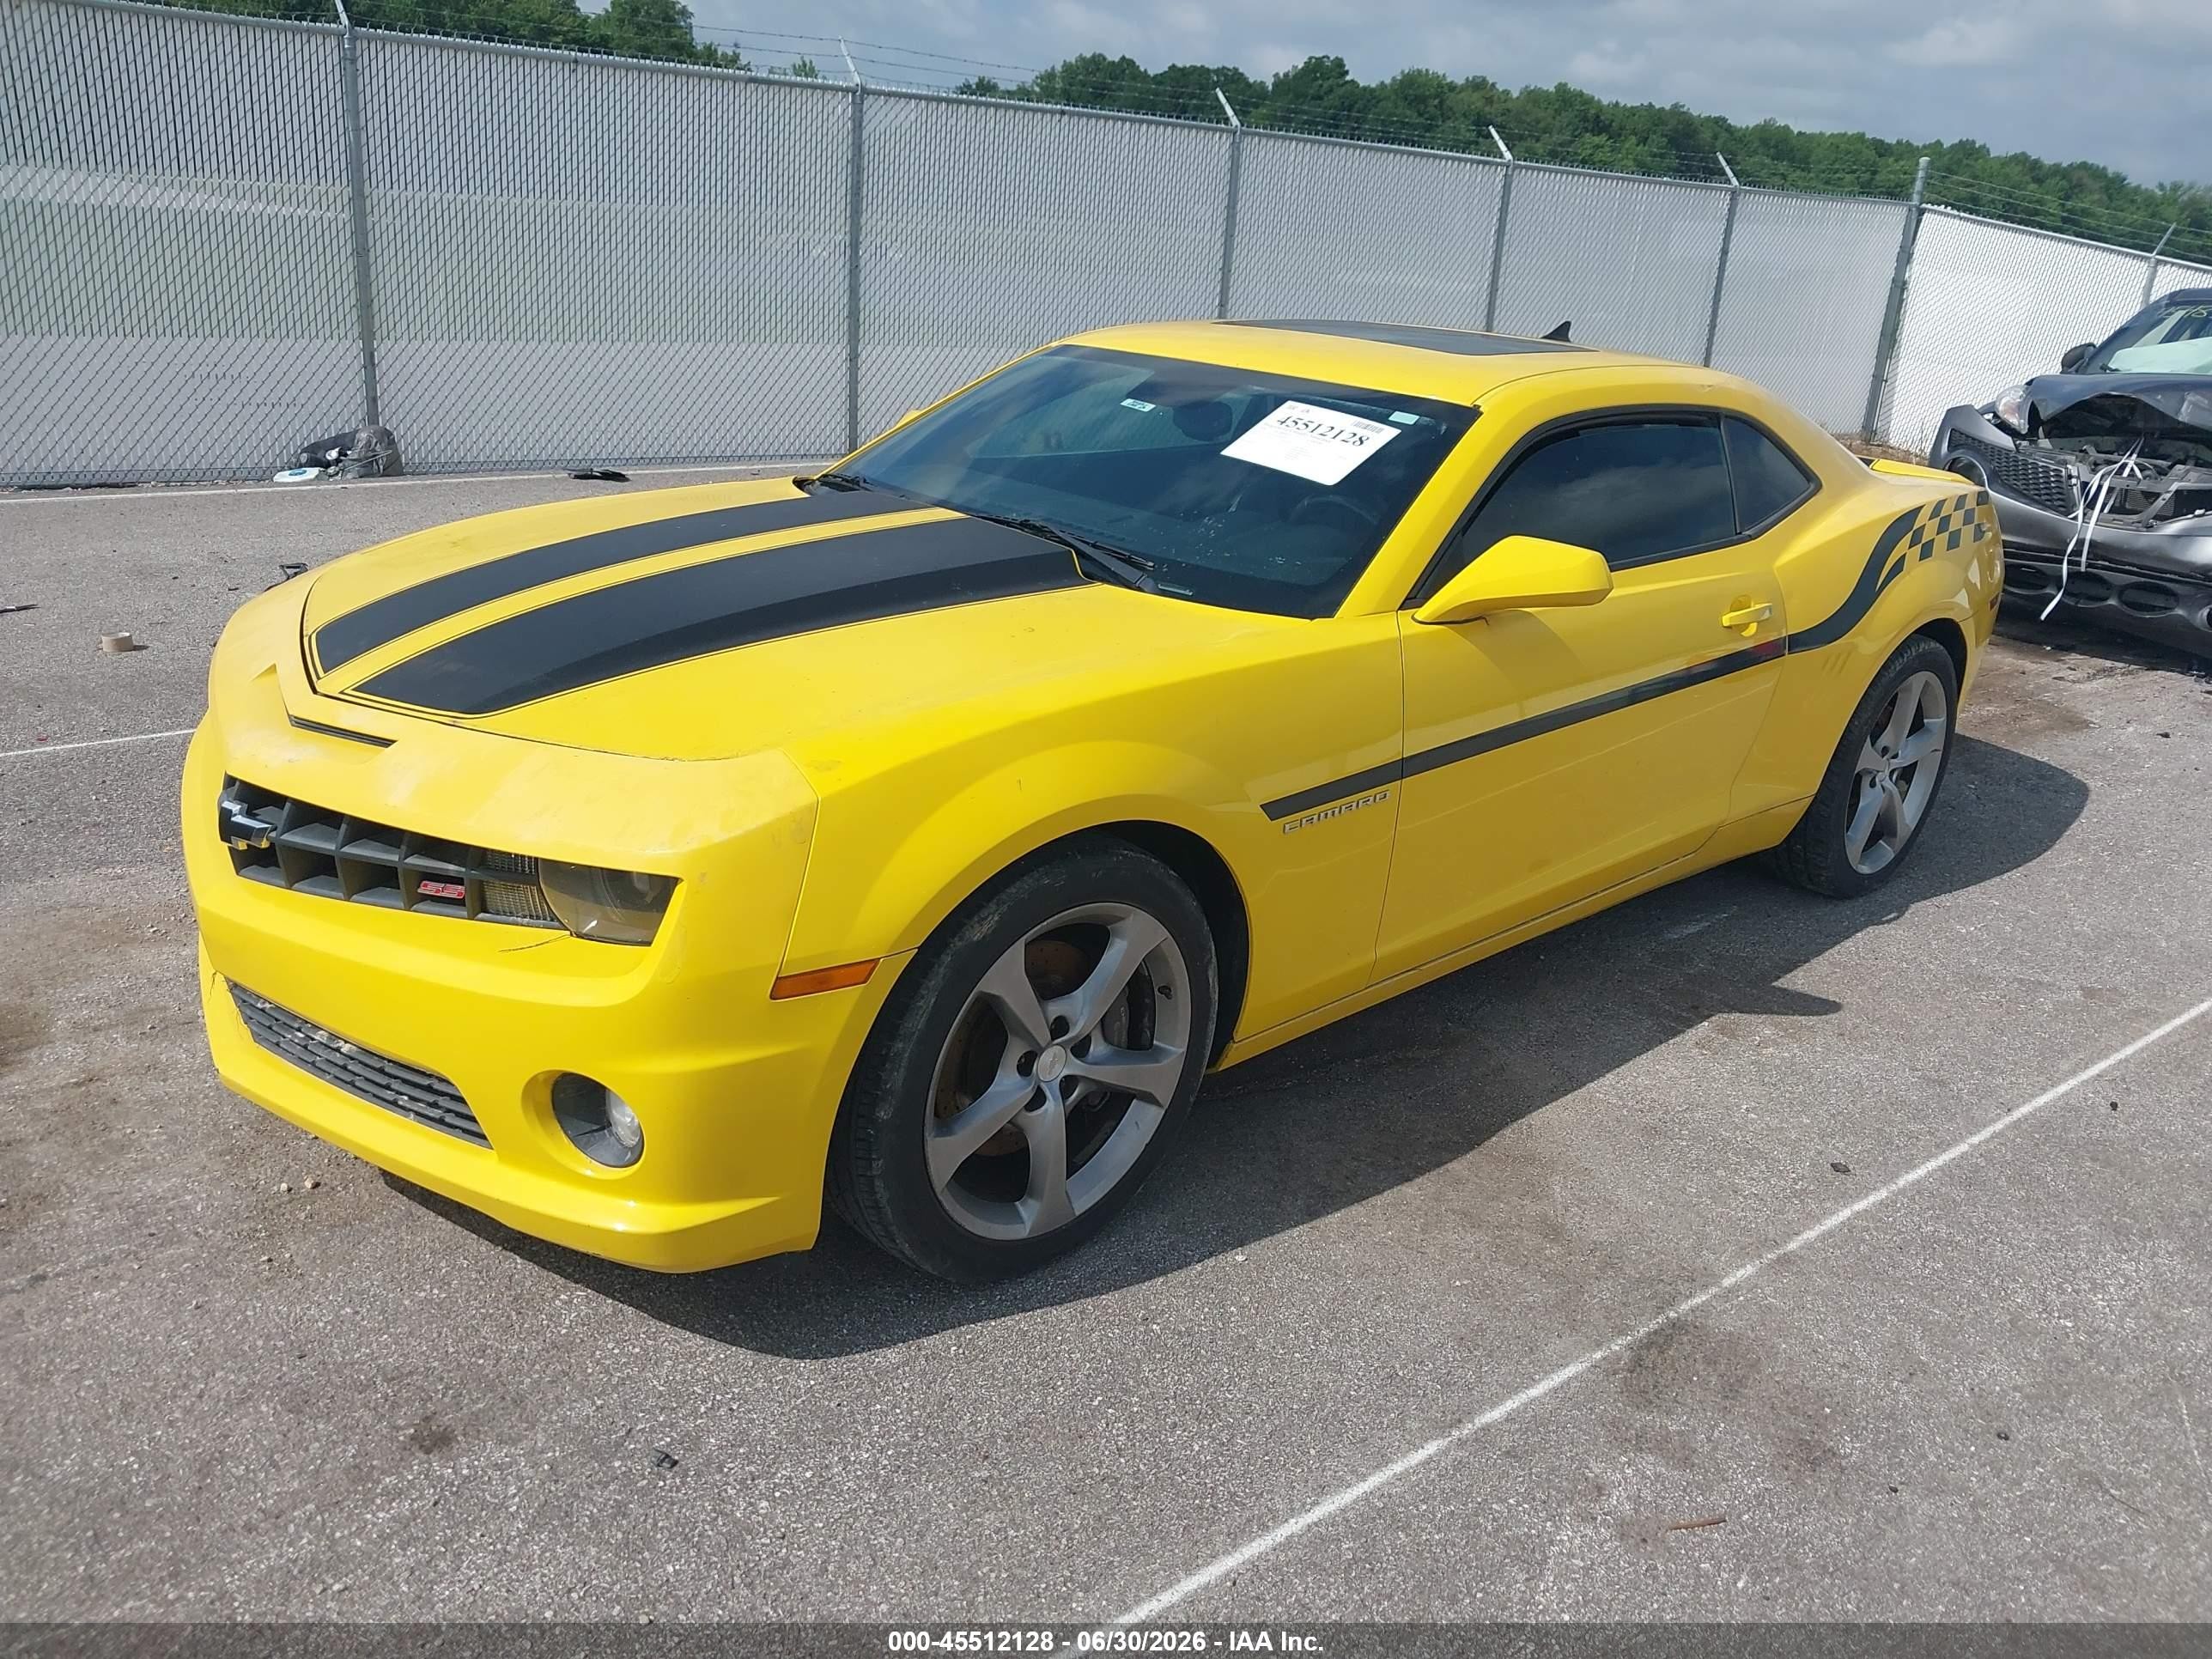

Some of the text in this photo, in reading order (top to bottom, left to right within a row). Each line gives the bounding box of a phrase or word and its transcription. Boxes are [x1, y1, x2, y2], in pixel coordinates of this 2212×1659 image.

[1277, 416, 1370, 447] 45512128
[1284, 789, 1389, 834] CAMARO
[417, 880, 465, 898] SS
